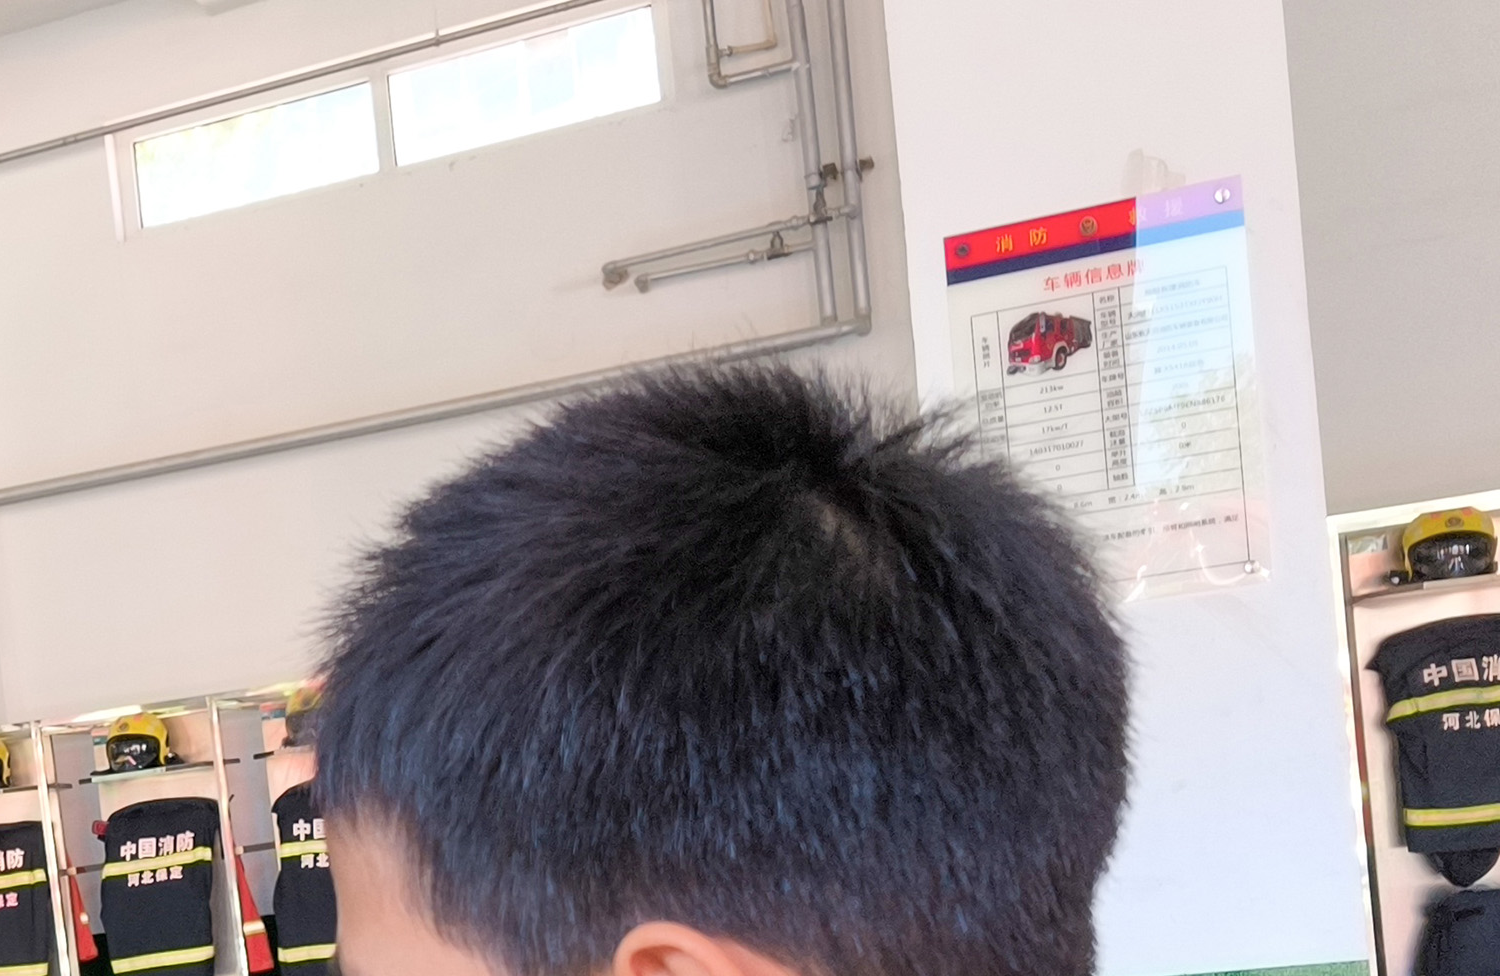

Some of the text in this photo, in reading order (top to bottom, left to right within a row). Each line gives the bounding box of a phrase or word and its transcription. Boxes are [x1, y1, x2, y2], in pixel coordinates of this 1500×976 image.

[996, 227, 1048, 253] 消防
[1043, 258, 1144, 293] 车辆信息牌
[120, 830, 195, 861] 中国消防
[127, 865, 184, 887] 河北保定
